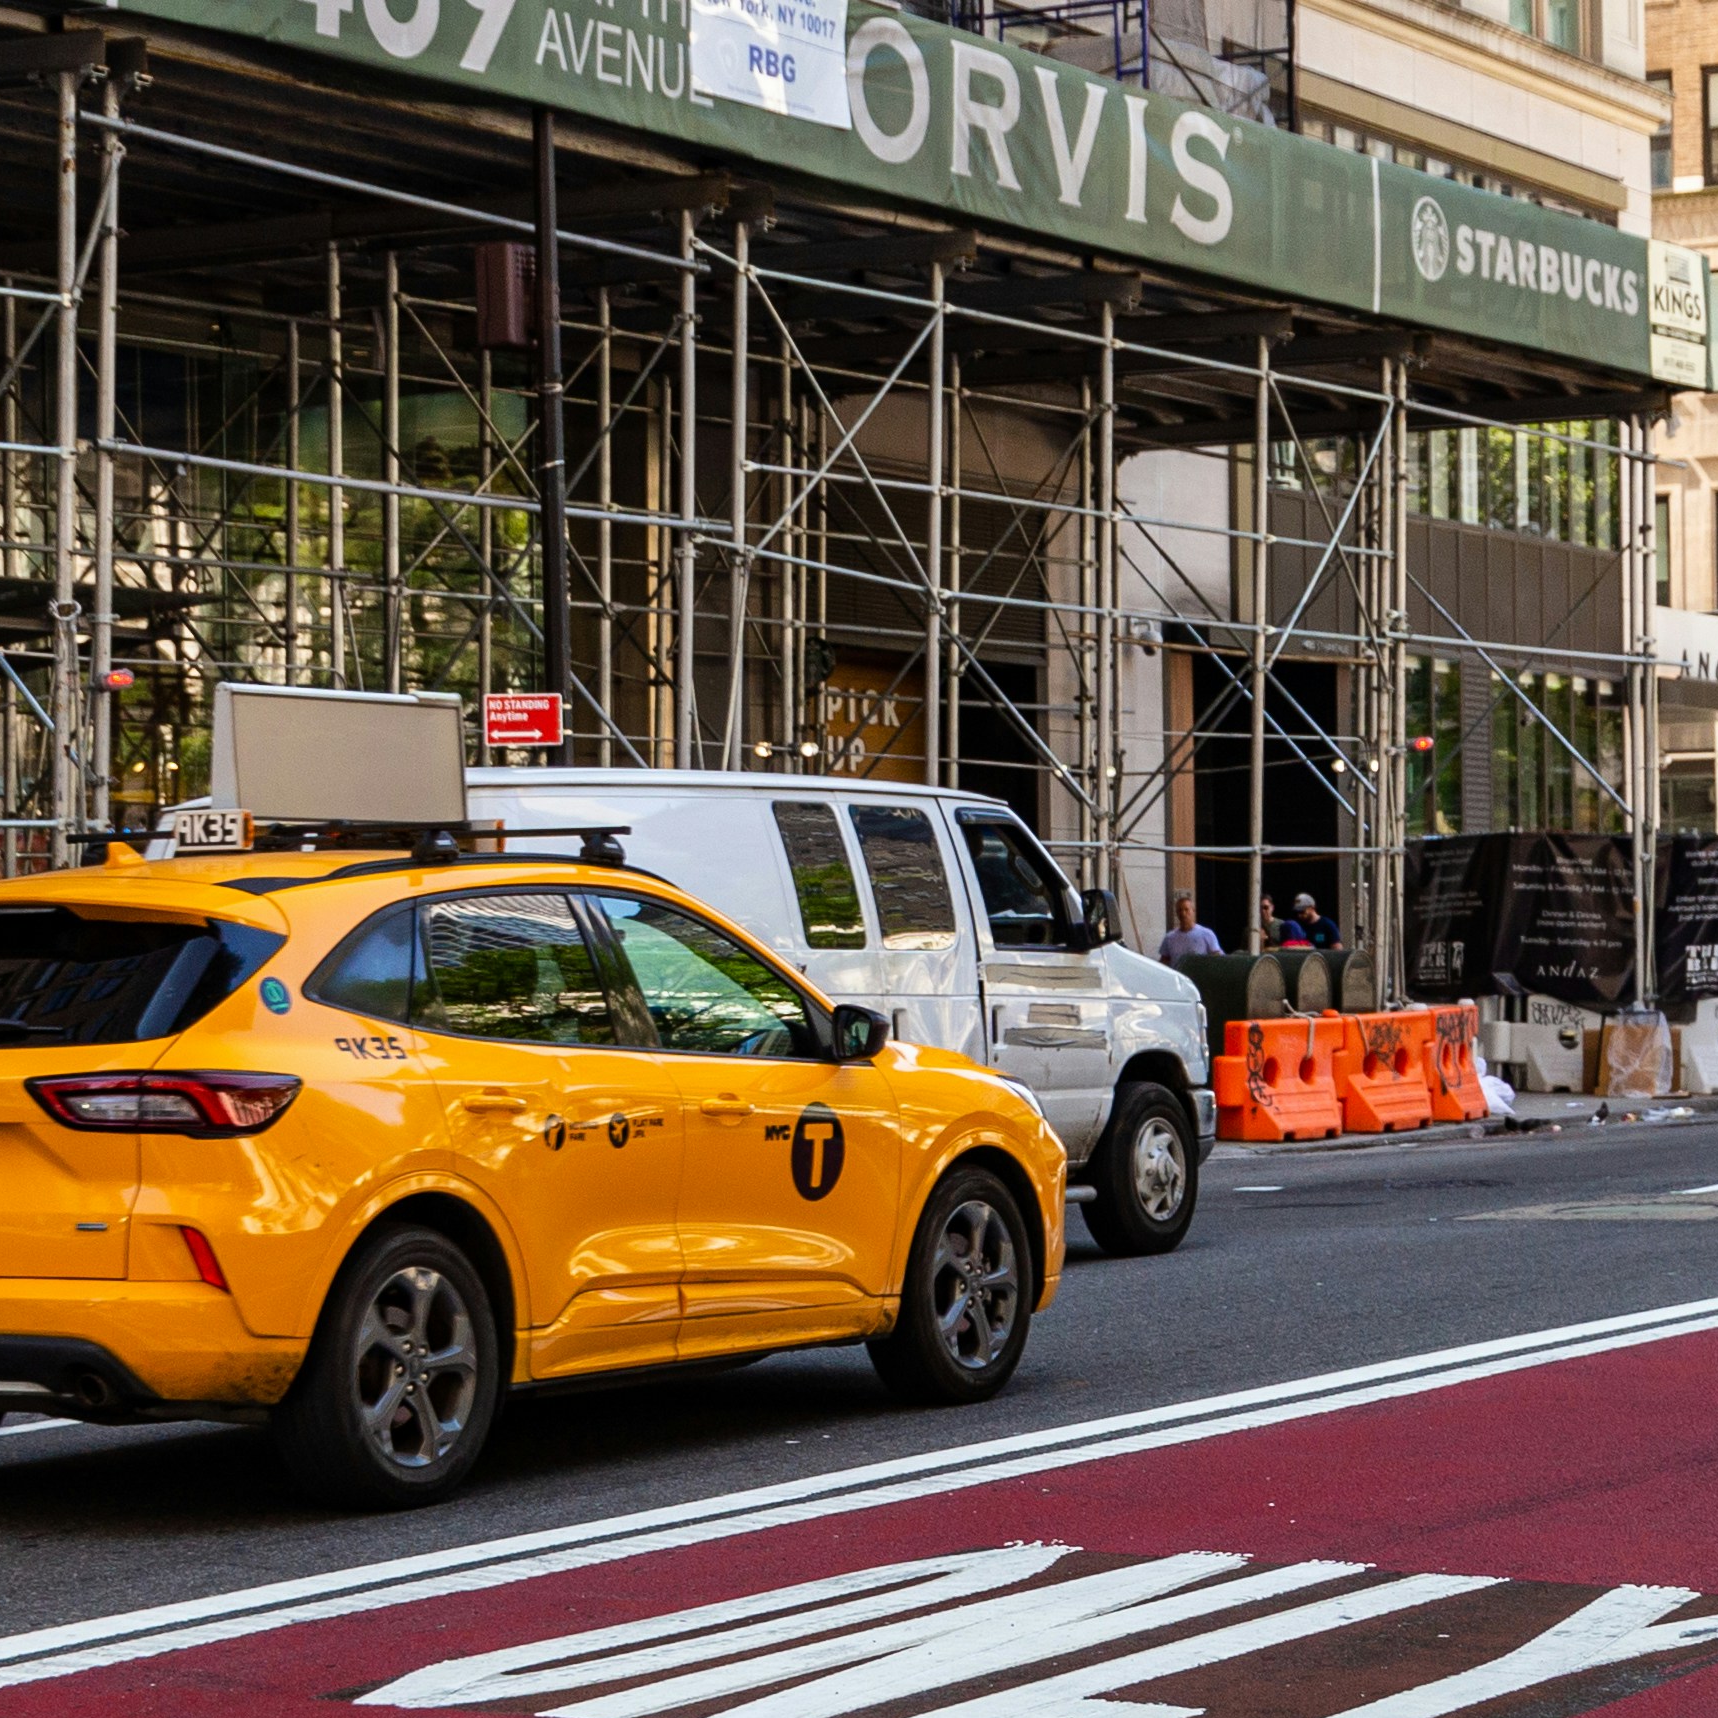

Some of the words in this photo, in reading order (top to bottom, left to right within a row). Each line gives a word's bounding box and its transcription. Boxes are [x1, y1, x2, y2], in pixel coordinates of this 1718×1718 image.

[778, 4, 796, 25] NY
[801, 12, 835, 39] 10017
[535, 8, 703, 107] AVENU
[749, 44, 796, 82] RBG
[846, 17, 1234, 245] ORVIS
[1456, 224, 1639, 316] STARBUCKS
[1653, 285, 1702, 320] KINGS
[488, 700, 503, 711] NO
[503, 699, 550, 711] STANDING
[490, 711, 529, 723] Anytime
[826, 686, 901, 728] PICK
[827, 735, 866, 773] UP
[764, 1124, 791, 1141] NYC
